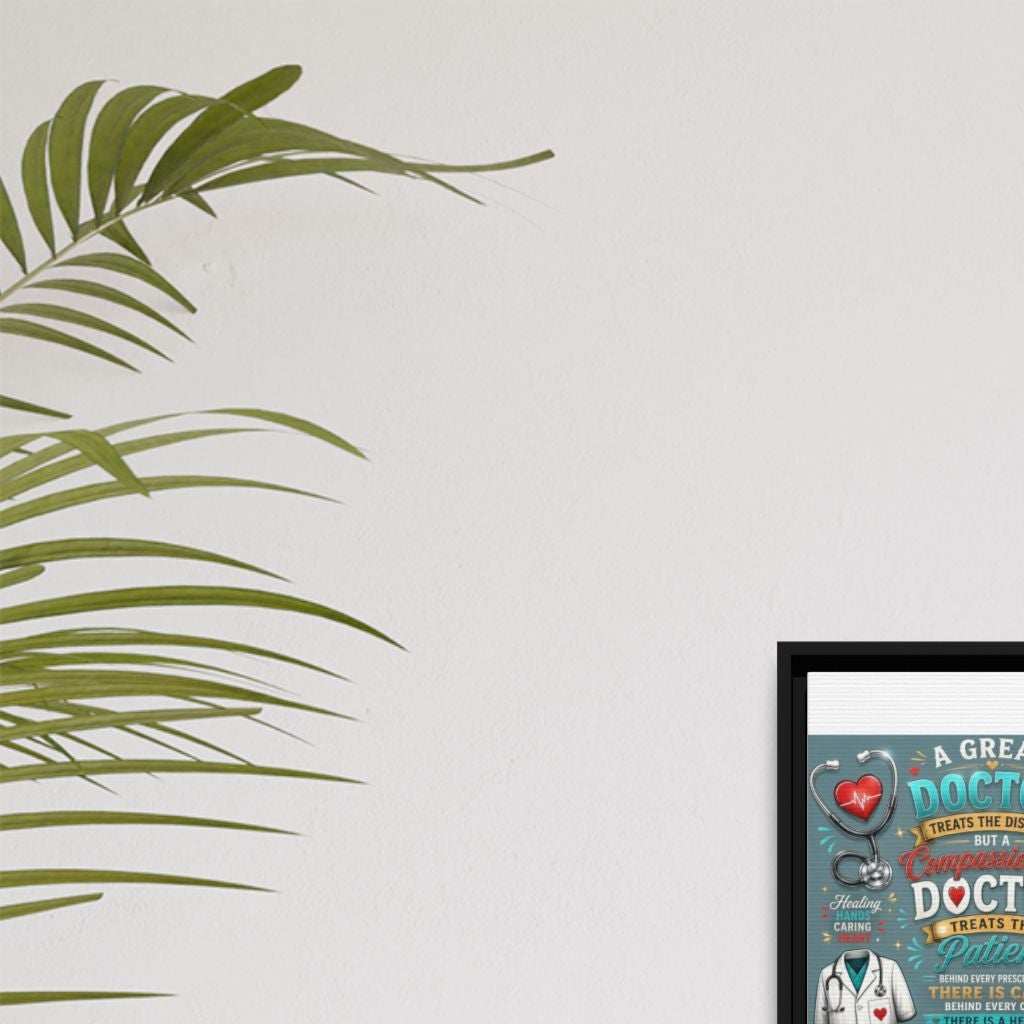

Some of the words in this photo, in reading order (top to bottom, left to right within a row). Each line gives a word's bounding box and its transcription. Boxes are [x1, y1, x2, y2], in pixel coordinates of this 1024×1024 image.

[934, 745, 952, 768] A
[929, 816, 974, 834] TREATS
[978, 816, 1000, 828] THE
[974, 834, 998, 846] BUT
[1002, 834, 1010, 846] A
[830, 894, 882, 914] Healing
[836, 910, 871, 920] HANDS
[834, 922, 872, 932] CARING
[950, 918, 1004, 932] TREATS
[940, 974, 968, 983] BEHIND
[970, 974, 996, 983] EVERY
[928, 986, 984, 1000] THERE
[989, 986, 1005, 1000] IS
[944, 1002, 982, 1011] BEHIND
[985, 1002, 1016, 1011] EVERY
